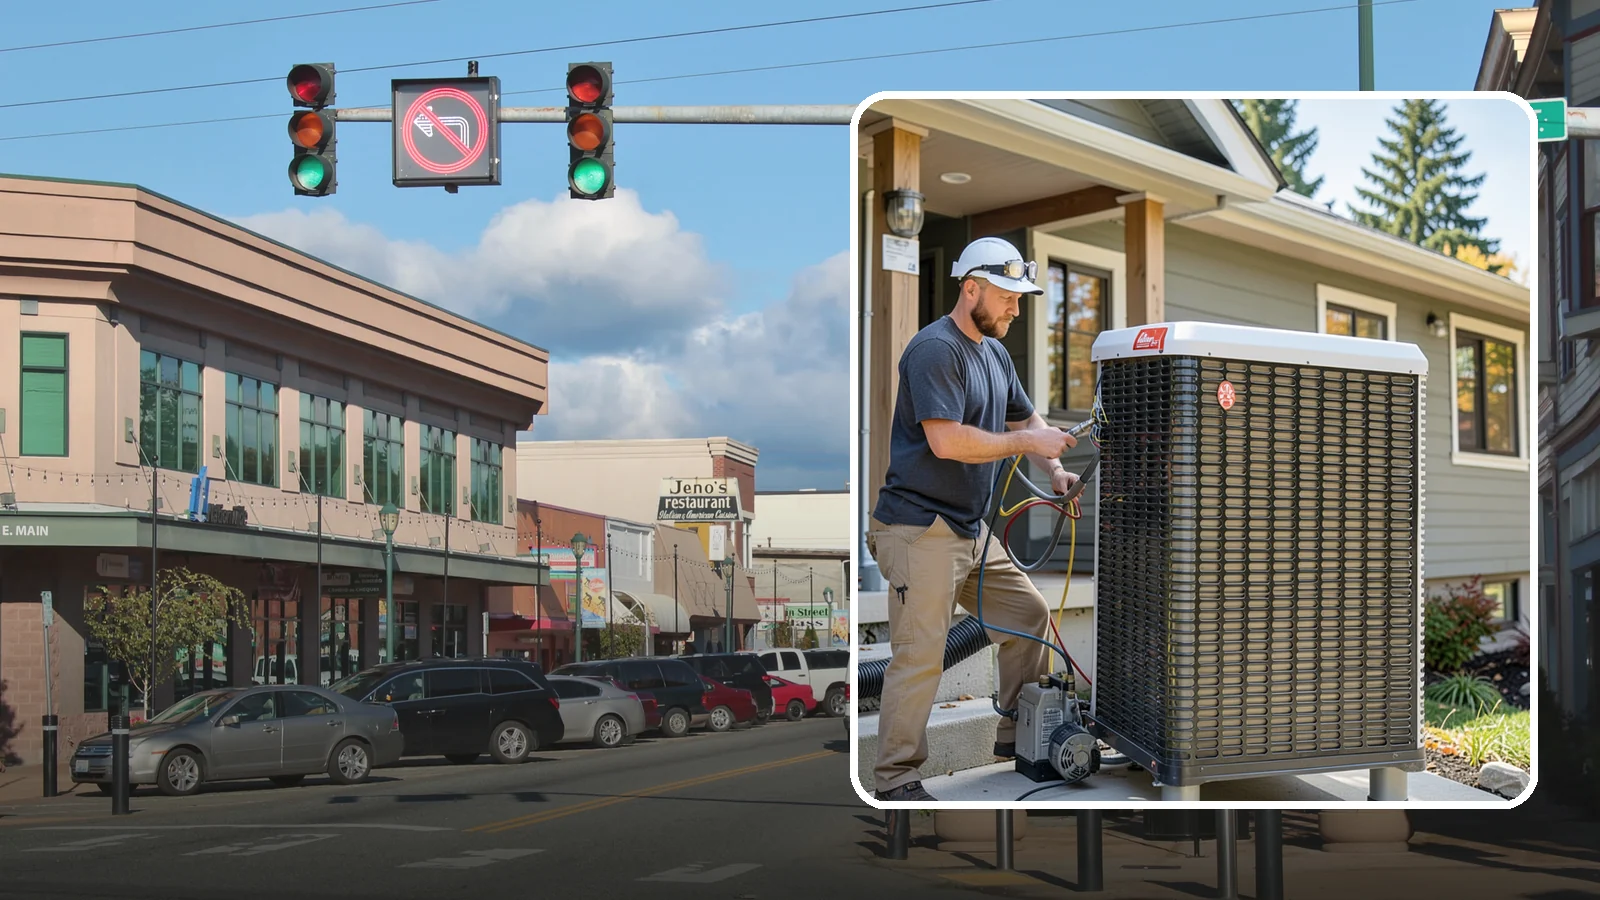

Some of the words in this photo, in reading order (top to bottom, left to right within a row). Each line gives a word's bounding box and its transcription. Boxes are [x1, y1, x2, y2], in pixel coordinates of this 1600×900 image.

[670, 480, 727, 495] Jeno's
[665, 497, 731, 509] restaurant
[659, 510, 681, 519] Italian
[686, 510, 714, 519] American
[715, 510, 737, 519] Cuisine
[2, 525, 13, 536] E.
[15, 525, 49, 536] MAIN
[798, 608, 828, 617] Street
